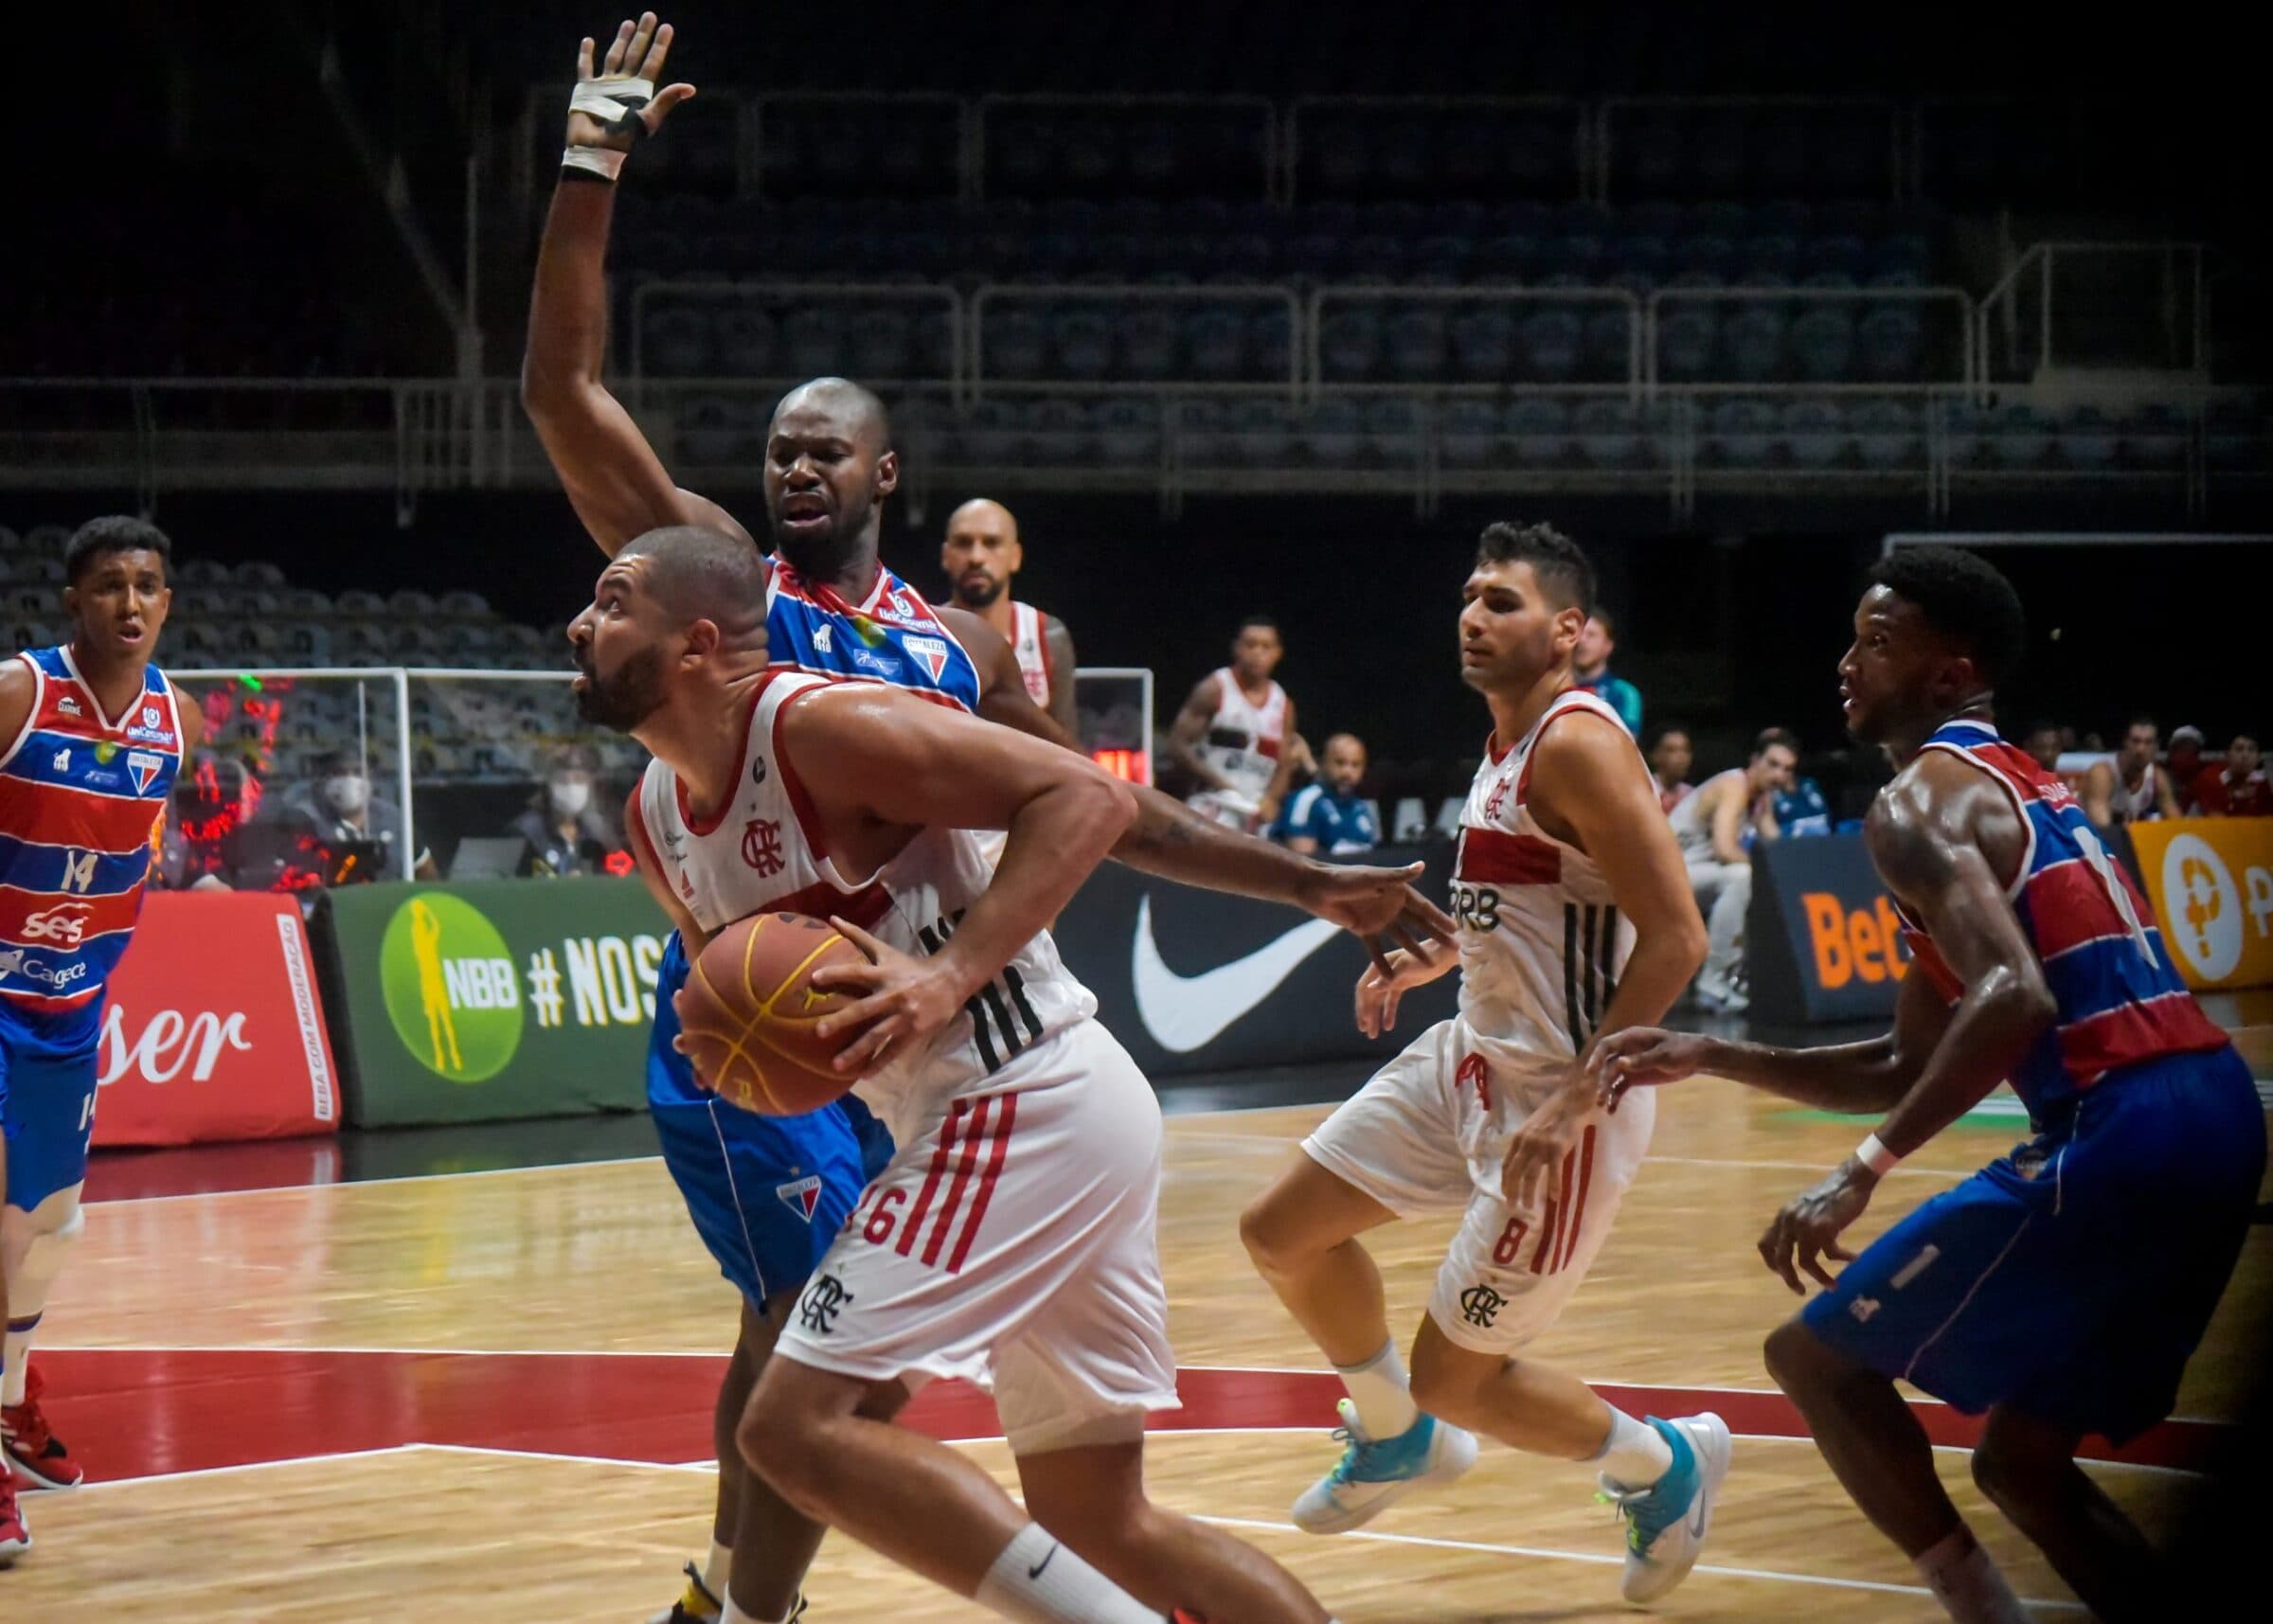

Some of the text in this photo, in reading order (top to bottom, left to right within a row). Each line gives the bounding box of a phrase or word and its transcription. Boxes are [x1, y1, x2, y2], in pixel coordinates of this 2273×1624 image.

[61, 850, 98, 893] 14
[21, 912, 89, 943] ses
[1801, 892, 1910, 988] Bet
[23, 959, 86, 990] Cagece
[442, 957, 520, 1009] NBB
[1493, 1217, 1529, 1264] 8
